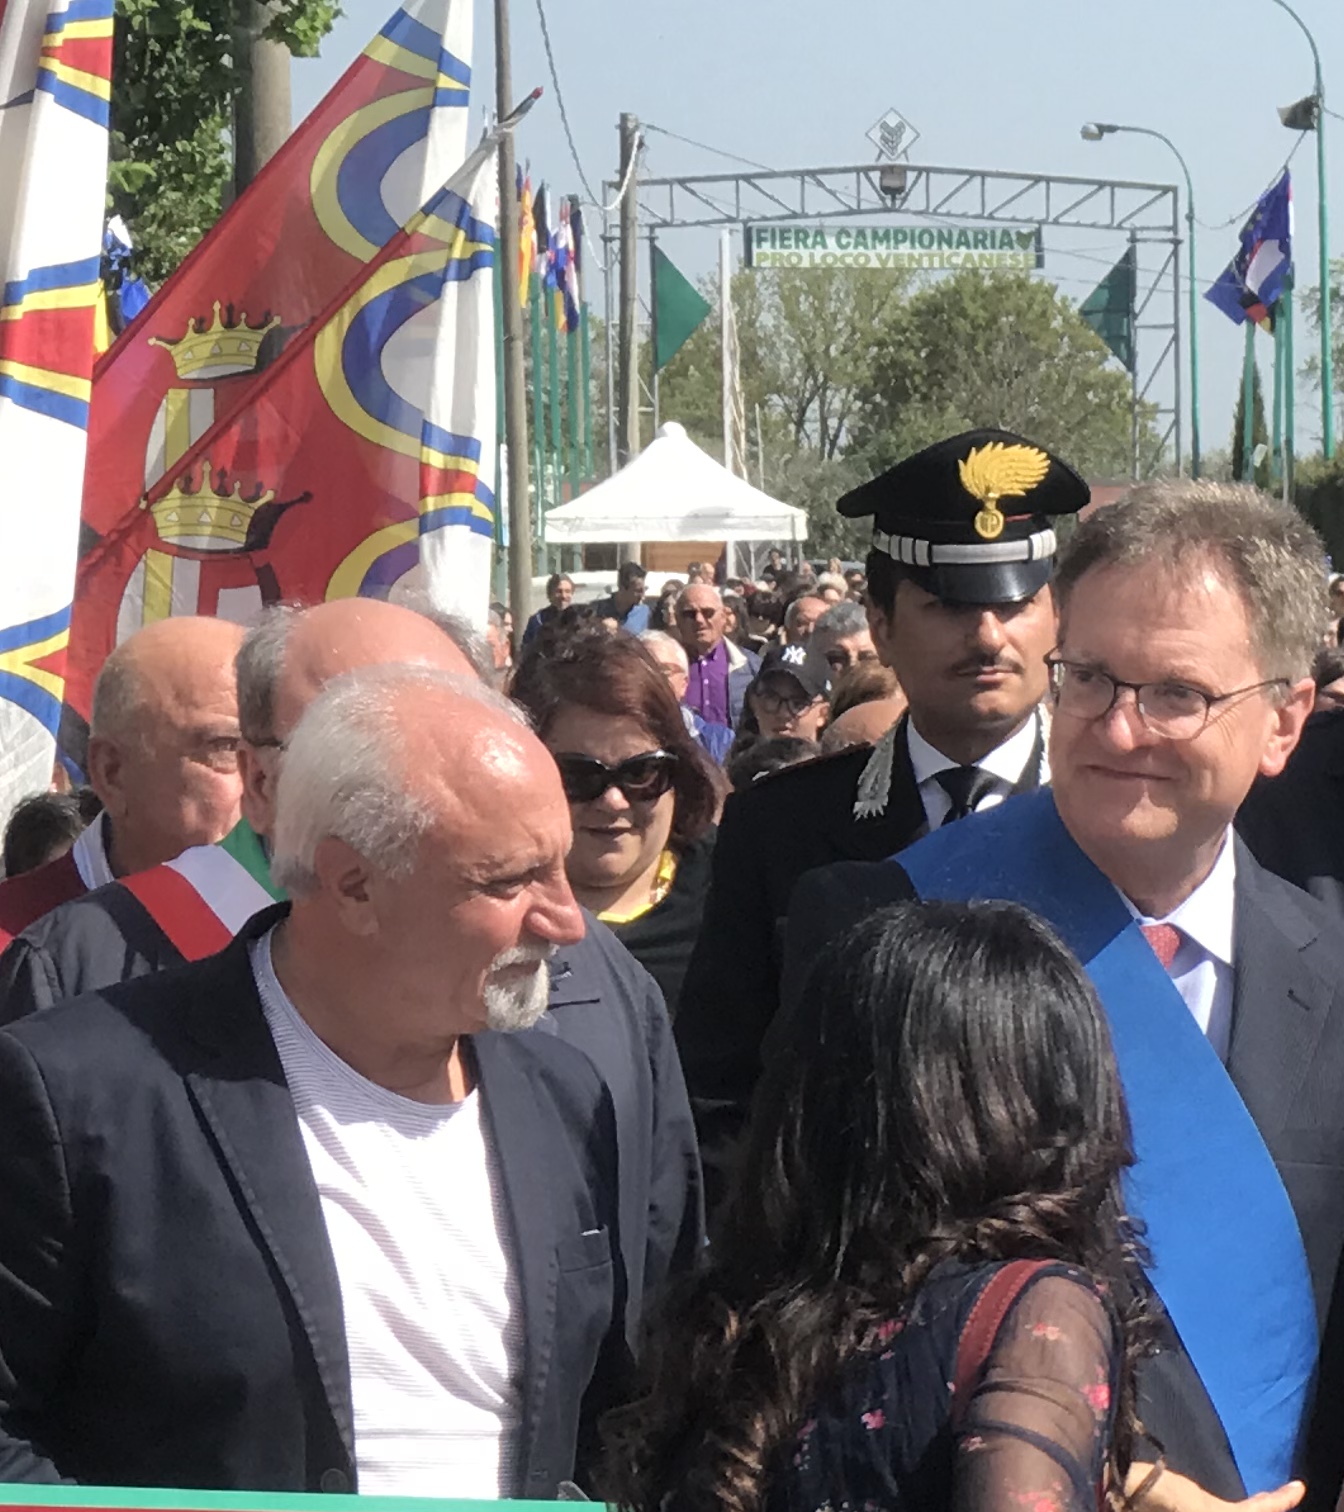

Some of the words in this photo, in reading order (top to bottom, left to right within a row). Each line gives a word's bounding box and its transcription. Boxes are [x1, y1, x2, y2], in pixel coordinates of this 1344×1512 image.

[755, 227, 828, 250] FIERA
[835, 227, 1015, 250] CAMPIONARIA
[755, 252, 803, 268] PRO
[809, 252, 871, 268] LOCO
[875, 252, 1036, 268] VENTICANESE
[781, 644, 807, 665] NY
